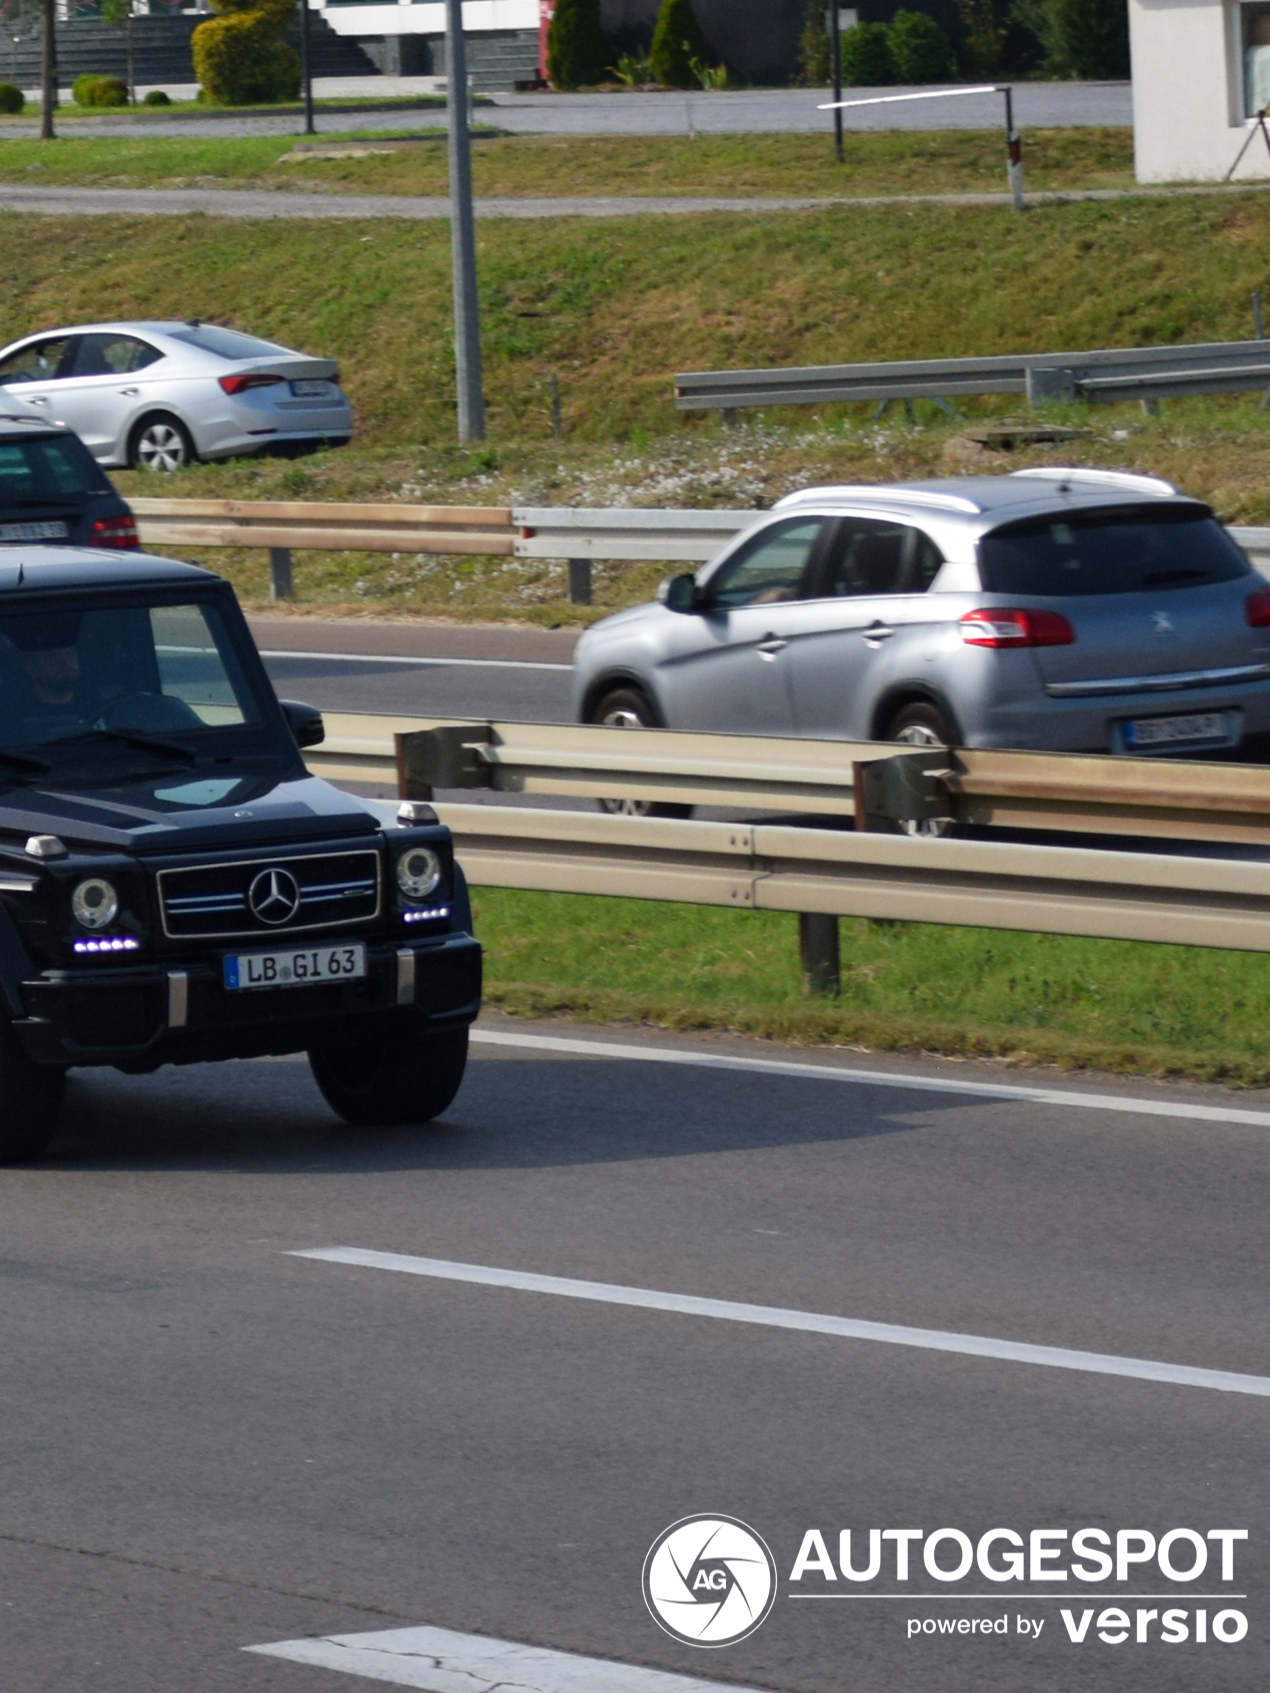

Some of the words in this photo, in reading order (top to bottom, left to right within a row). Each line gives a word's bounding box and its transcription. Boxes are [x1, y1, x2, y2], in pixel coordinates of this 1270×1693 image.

[247, 957, 277, 983] LB
[292, 953, 321, 978] GI
[328, 949, 355, 975] 63
